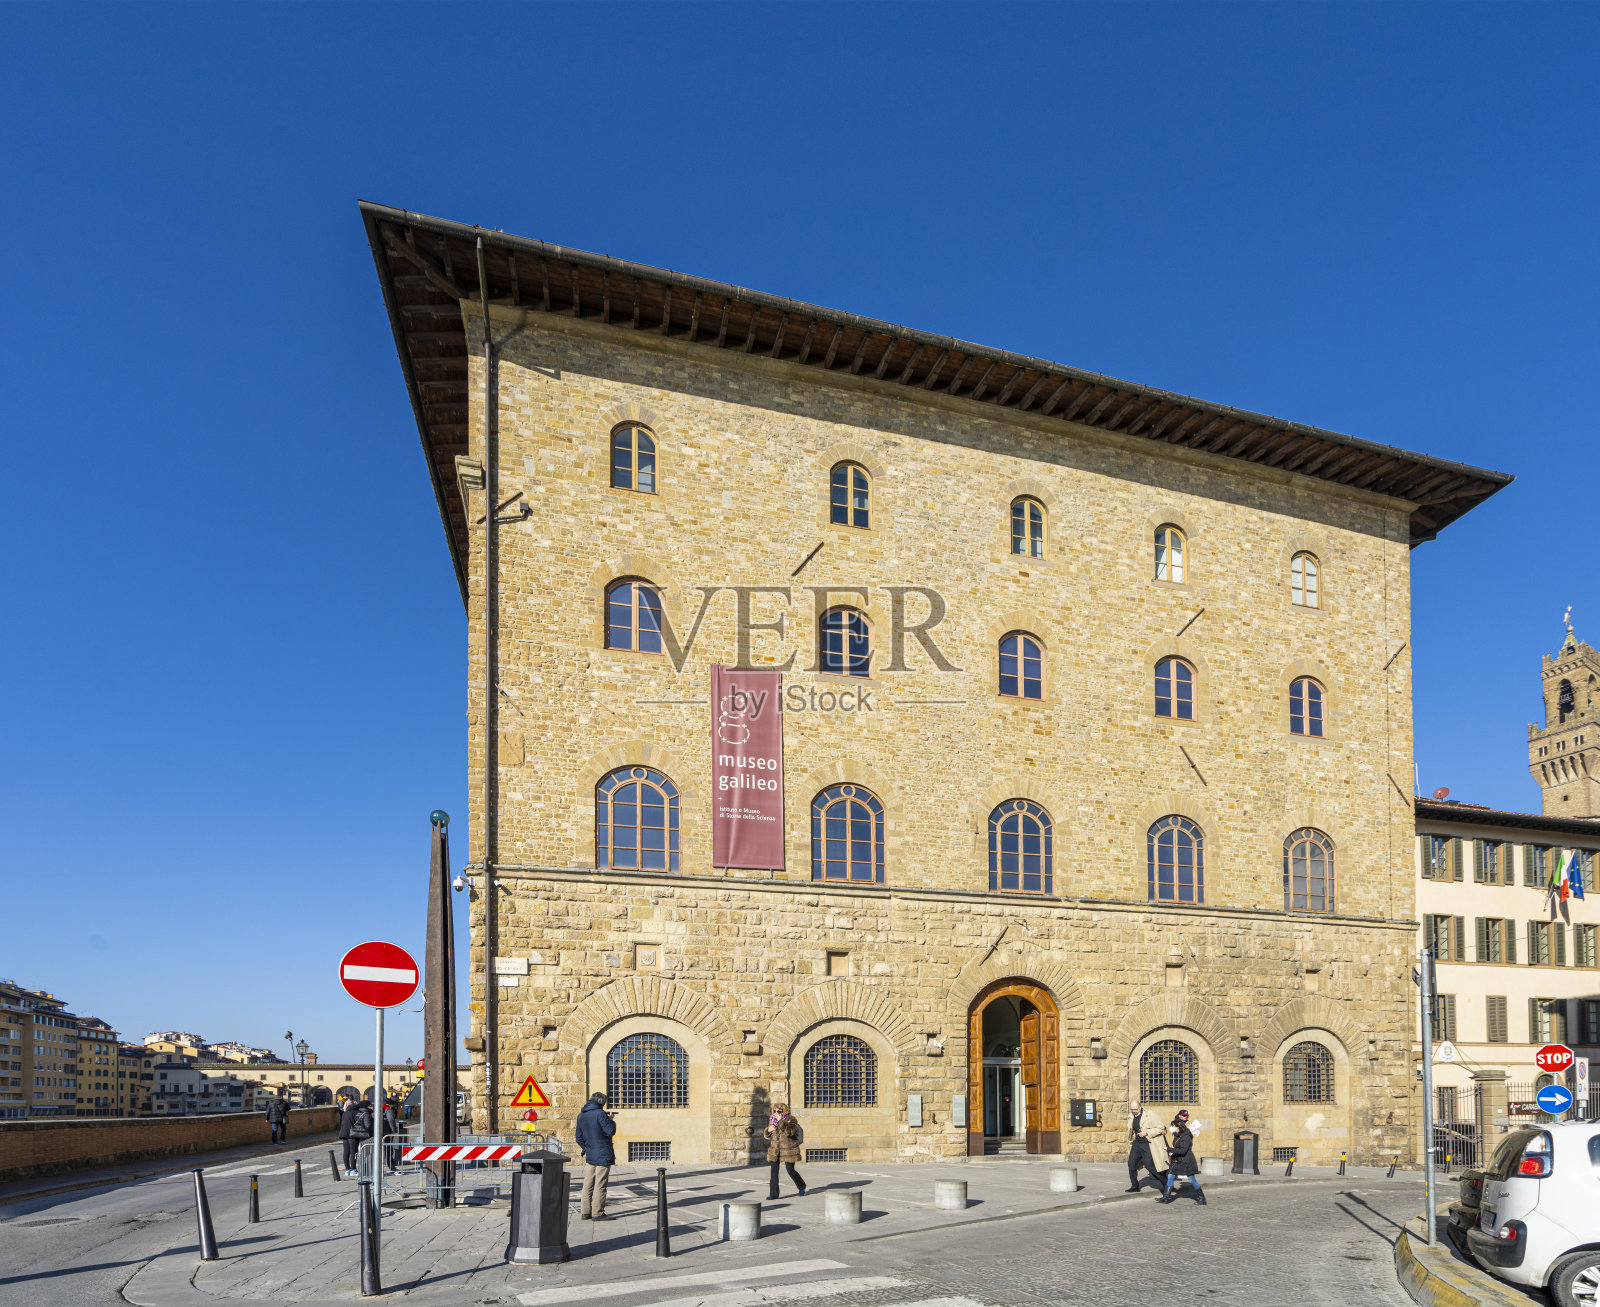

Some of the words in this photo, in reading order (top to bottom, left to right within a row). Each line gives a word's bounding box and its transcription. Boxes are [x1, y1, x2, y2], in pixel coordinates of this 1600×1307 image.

[719, 754, 777, 770] museo
[719, 773, 778, 790] galileo
[1537, 1053, 1572, 1065] STOP
[1521, 1103, 1541, 1111] CARAB
